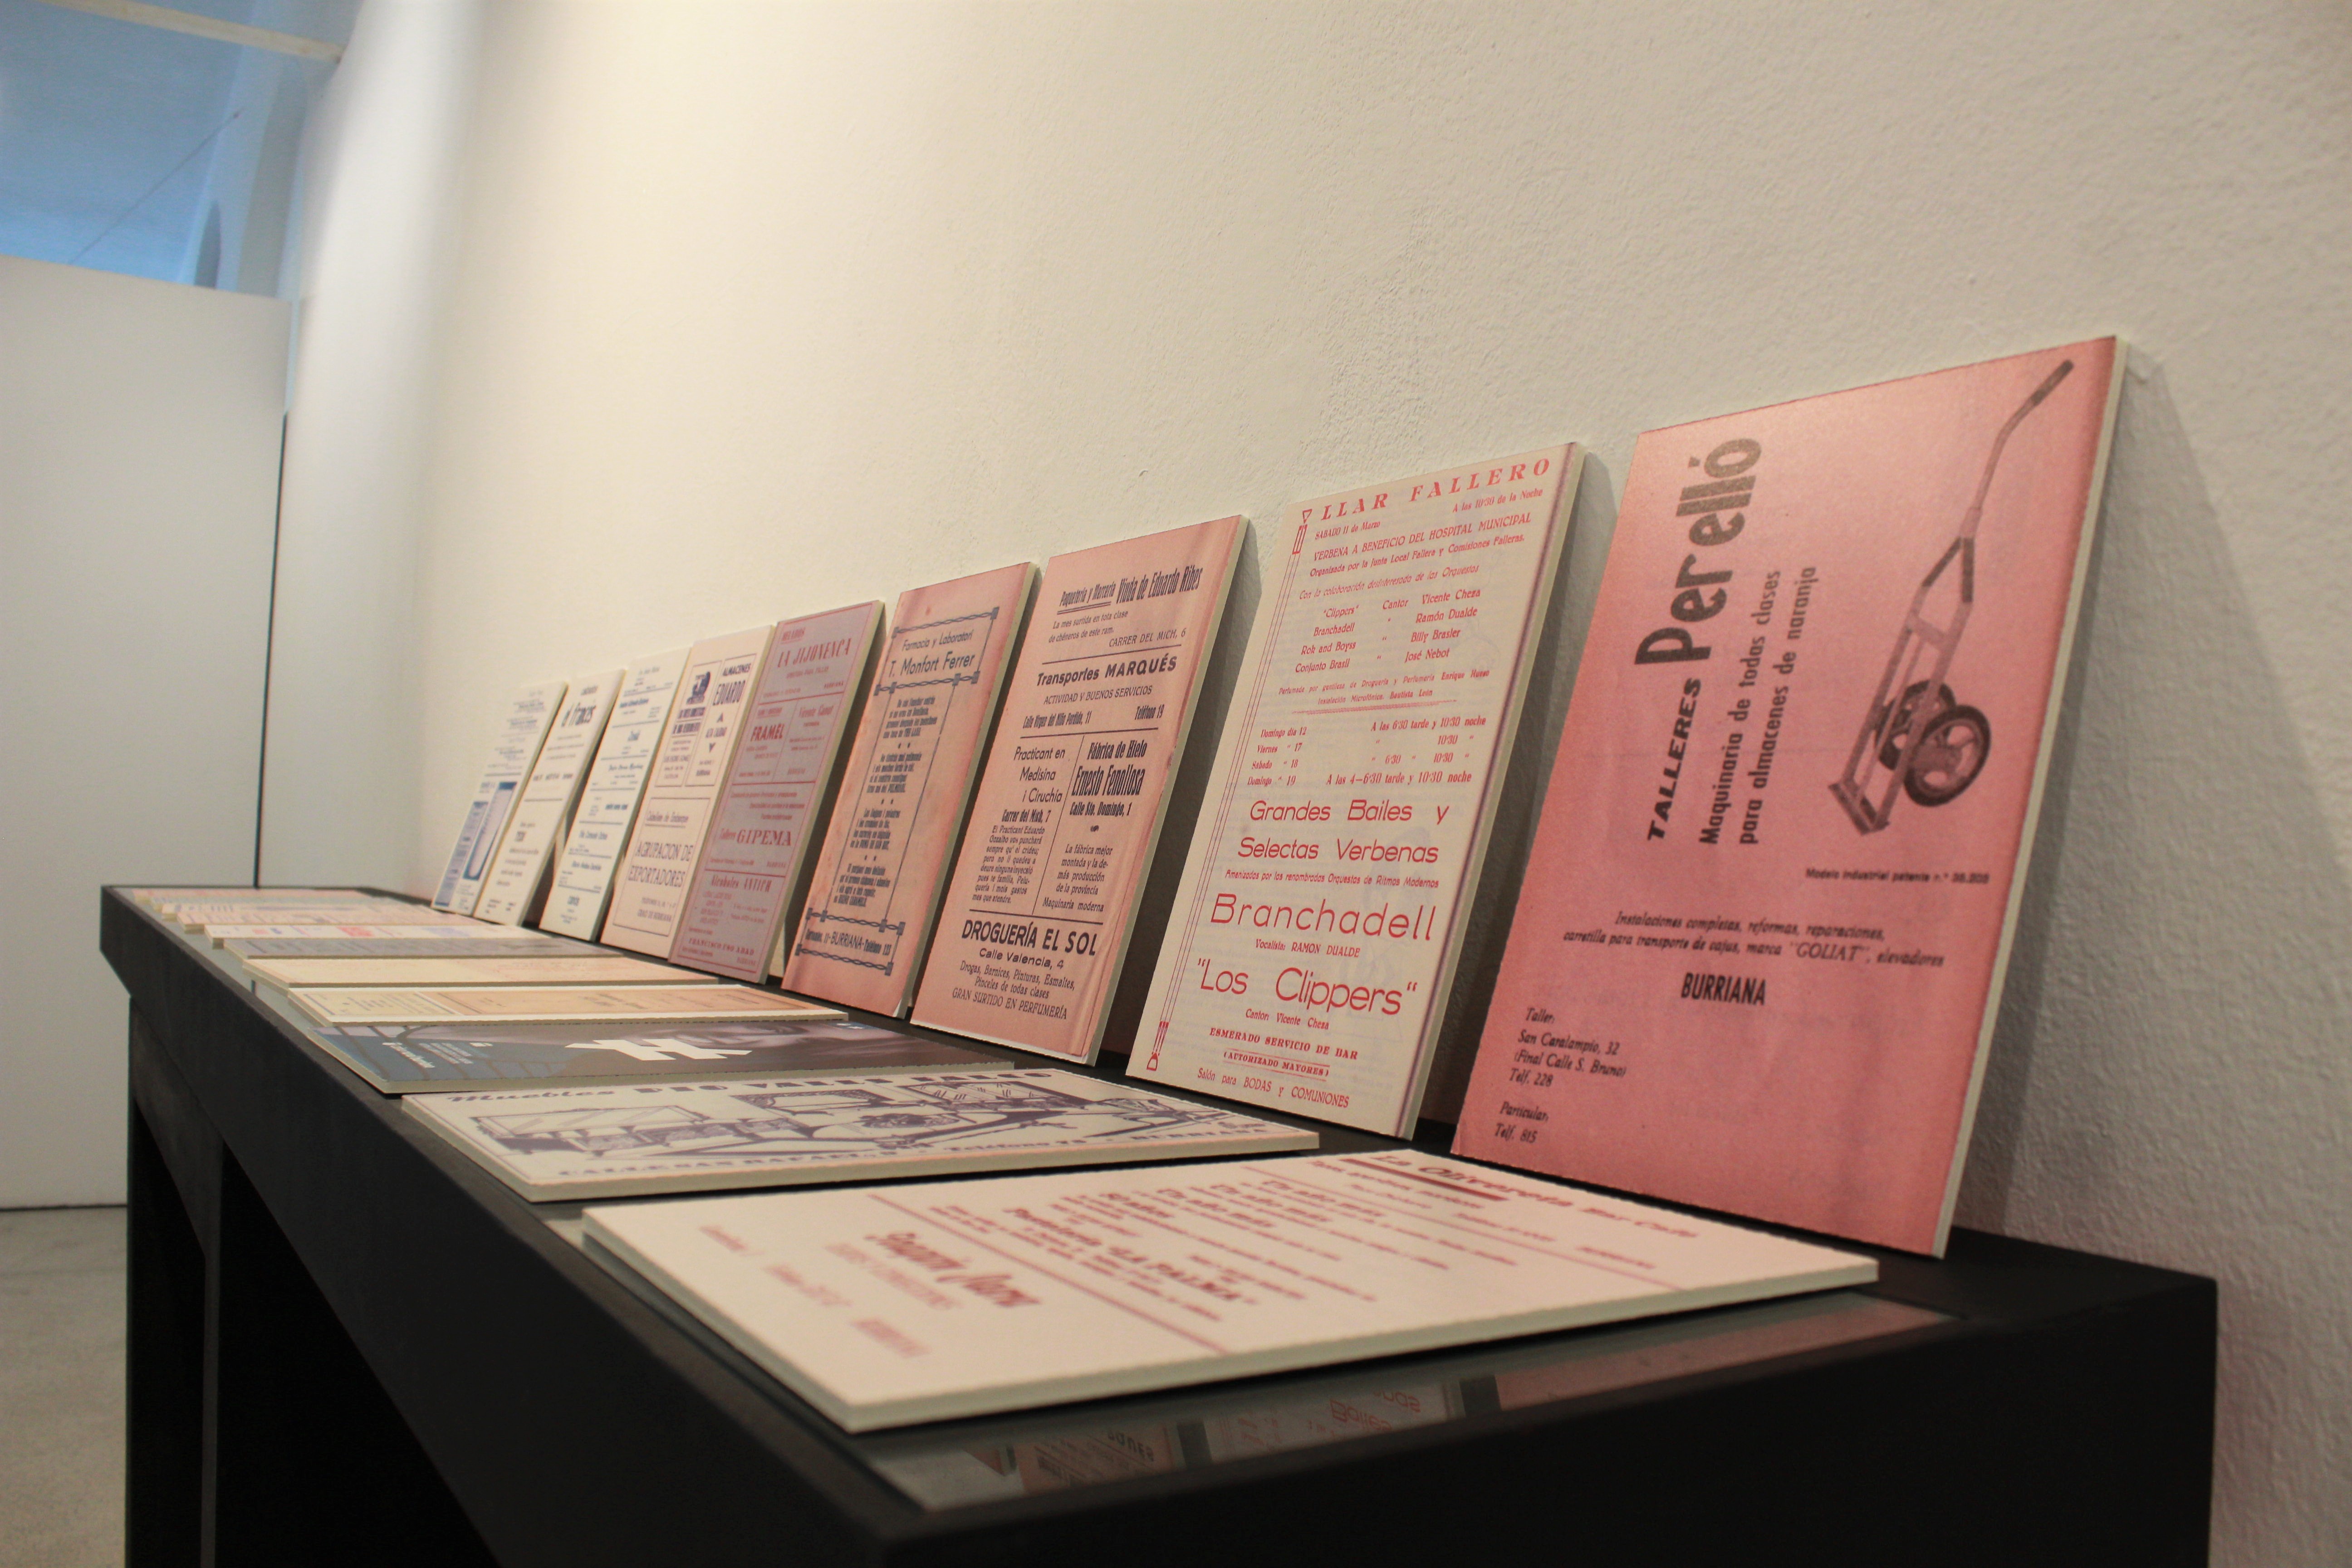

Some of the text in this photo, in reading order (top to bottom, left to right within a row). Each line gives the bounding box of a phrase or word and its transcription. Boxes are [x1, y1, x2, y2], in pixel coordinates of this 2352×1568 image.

[1321, 459, 1549, 520] LLAR FALLERO
[1313, 512, 1531, 561] VERBENA A BENEFICIO DEL HOSPITAL MUNICIPAL
[1343, 525, 1349, 534] 11
[1351, 524, 1358, 533] de
[1361, 521, 1381, 530] Marzo
[1633, 439, 1761, 665] Perelló
[1116, 564, 1203, 604] Viuda de Eduardo Ribes
[1382, 599, 1409, 610] Cantor
[1422, 592, 1450, 604] Vicente
[1415, 606, 1478, 623] Ramón Dualde
[902, 639, 930, 651] Farmacia
[938, 629, 974, 645] Laboratori
[1109, 627, 1186, 647] CARRER DEL MICH, 6
[1313, 622, 1355, 637] Branchadell
[1410, 631, 1429, 643] Billy
[1318, 642, 1333, 653] and
[1404, 647, 1450, 663] José Nebot
[888, 660, 897, 677] T.
[1037, 652, 1177, 686] Transportes MARQUÉS
[1295, 658, 1350, 673] Conjunto Brasil
[712, 680, 746, 706] EDUARDO
[1043, 685, 1152, 705] ACTIVIDAD Y BUENOS SERVICIOS
[1698, 570, 1780, 845] Maquinaria de todas clases
[1739, 567, 1818, 845] para almacenes de naranja
[750, 723, 784, 741] FRAMEL
[1013, 746, 1065, 760] Practicant en
[1086, 739, 1147, 760] Fábrica de Hielo
[1646, 678, 1701, 841] TALLERES
[1019, 766, 1056, 781] Medisina
[1071, 764, 1146, 796] Ernesto Fenollosa
[1022, 787, 1063, 803] i Ciruchía
[1250, 799, 1449, 825] Grandes Bailes y
[736, 829, 791, 846] GIPEMA
[1237, 837, 1439, 863] Selectas Verbenas
[627, 865, 686, 887] EXPORTADORES
[1042, 897, 1104, 912] Maquinaria moderna
[1210, 893, 1436, 941] Branchadell
[961, 919, 1097, 956] DROGUERÍA EL SOL
[1255, 938, 1361, 958] Vocalista: RAMON DUALDE
[979, 947, 1064, 970] Calle Valencia, 4
[960, 960, 1074, 991] Drogas, Barnices, Pinturas, Esmaltes,
[974, 975, 1049, 999] Pinceles de todas clases
[1680, 972, 1765, 1006] BURRIANA
[952, 987, 1067, 1019] GRAN SURTIDO EN PERFUMERÍA
[1276, 1012, 1301, 1025] Vicente
[1209, 1027, 1358, 1060] ESMERADO SERVICIO DE BAR
[1517, 1029, 1537, 1044] San
[1605, 1041, 1620, 1056] 32
[1546, 1053, 1573, 1070] Calle
[1575, 1057, 1584, 1071] S.
[446, 1091, 615, 1102] Muebles
[1197, 1067, 1349, 1108] Salón para BODAS y COMUNIONES
